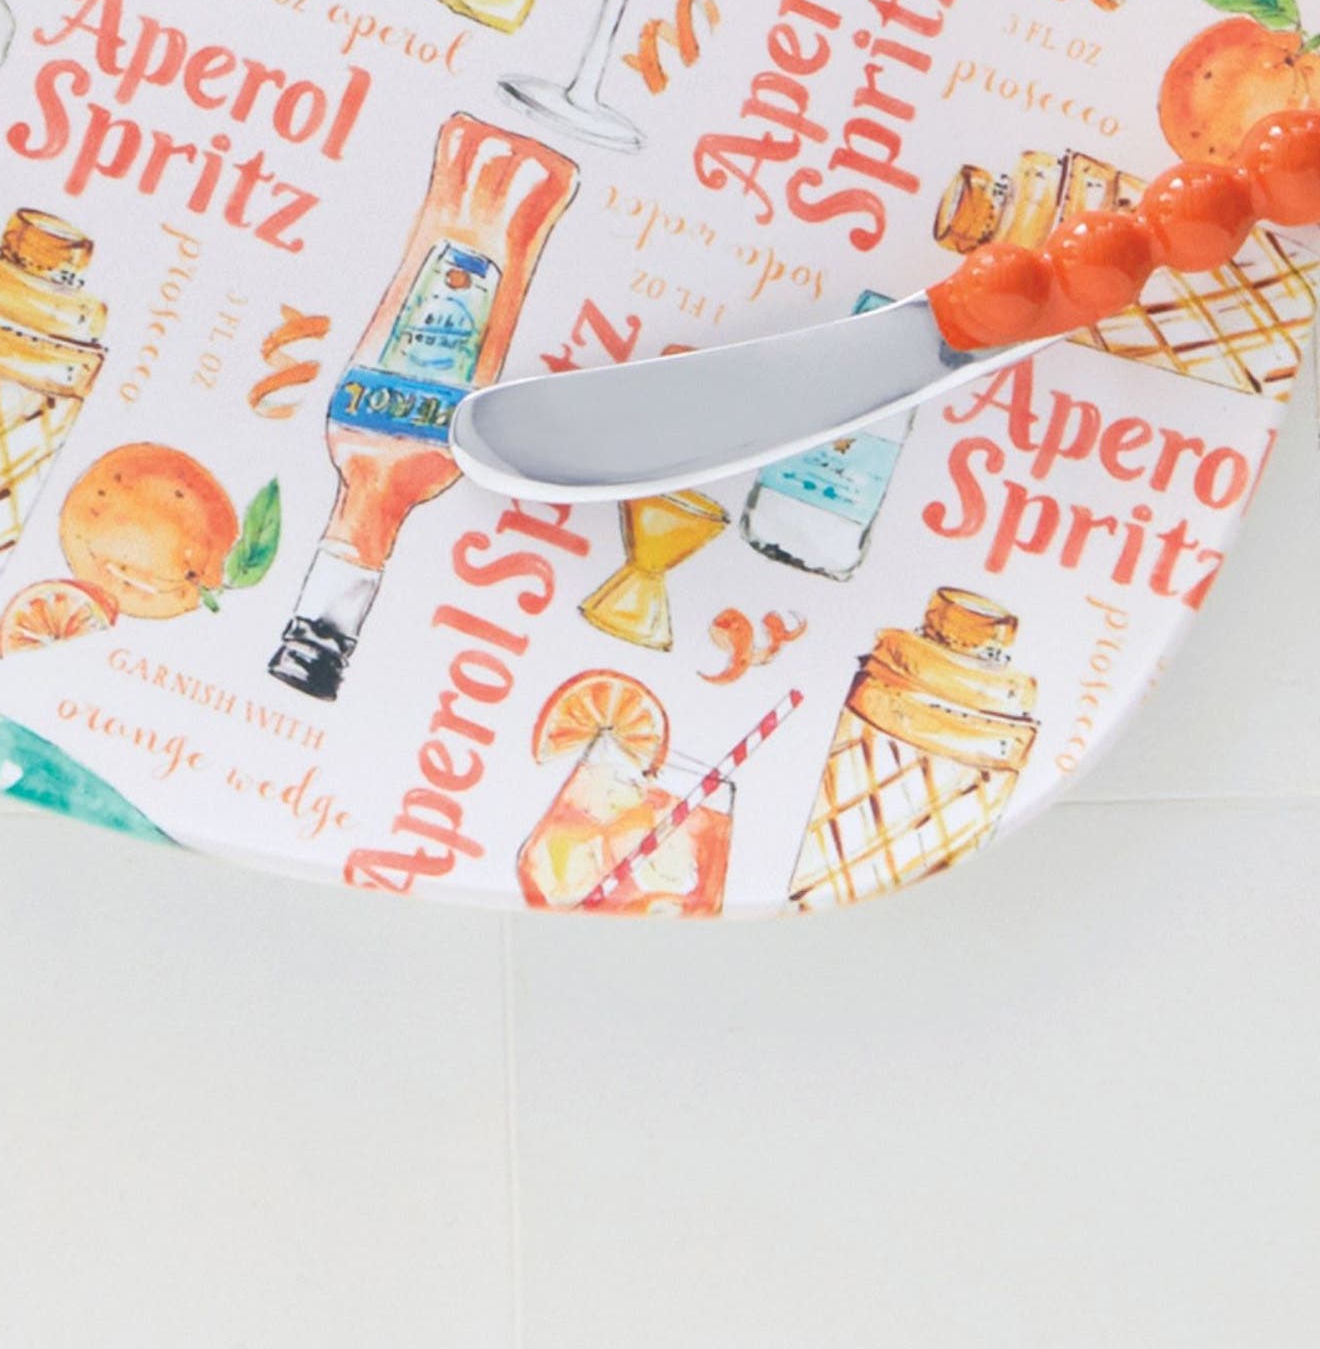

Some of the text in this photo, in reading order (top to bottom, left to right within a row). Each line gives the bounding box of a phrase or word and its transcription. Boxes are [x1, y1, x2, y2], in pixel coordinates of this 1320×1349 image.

[327, 1, 473, 76] aperol
[5, 58, 321, 254] Spritz
[342, 379, 454, 427] PEROL
[922, 437, 1226, 612] Spritz
[56, 698, 206, 781] orange
[107, 645, 328, 752] GARNISH WITH
[343, 603, 530, 895] Aperol
